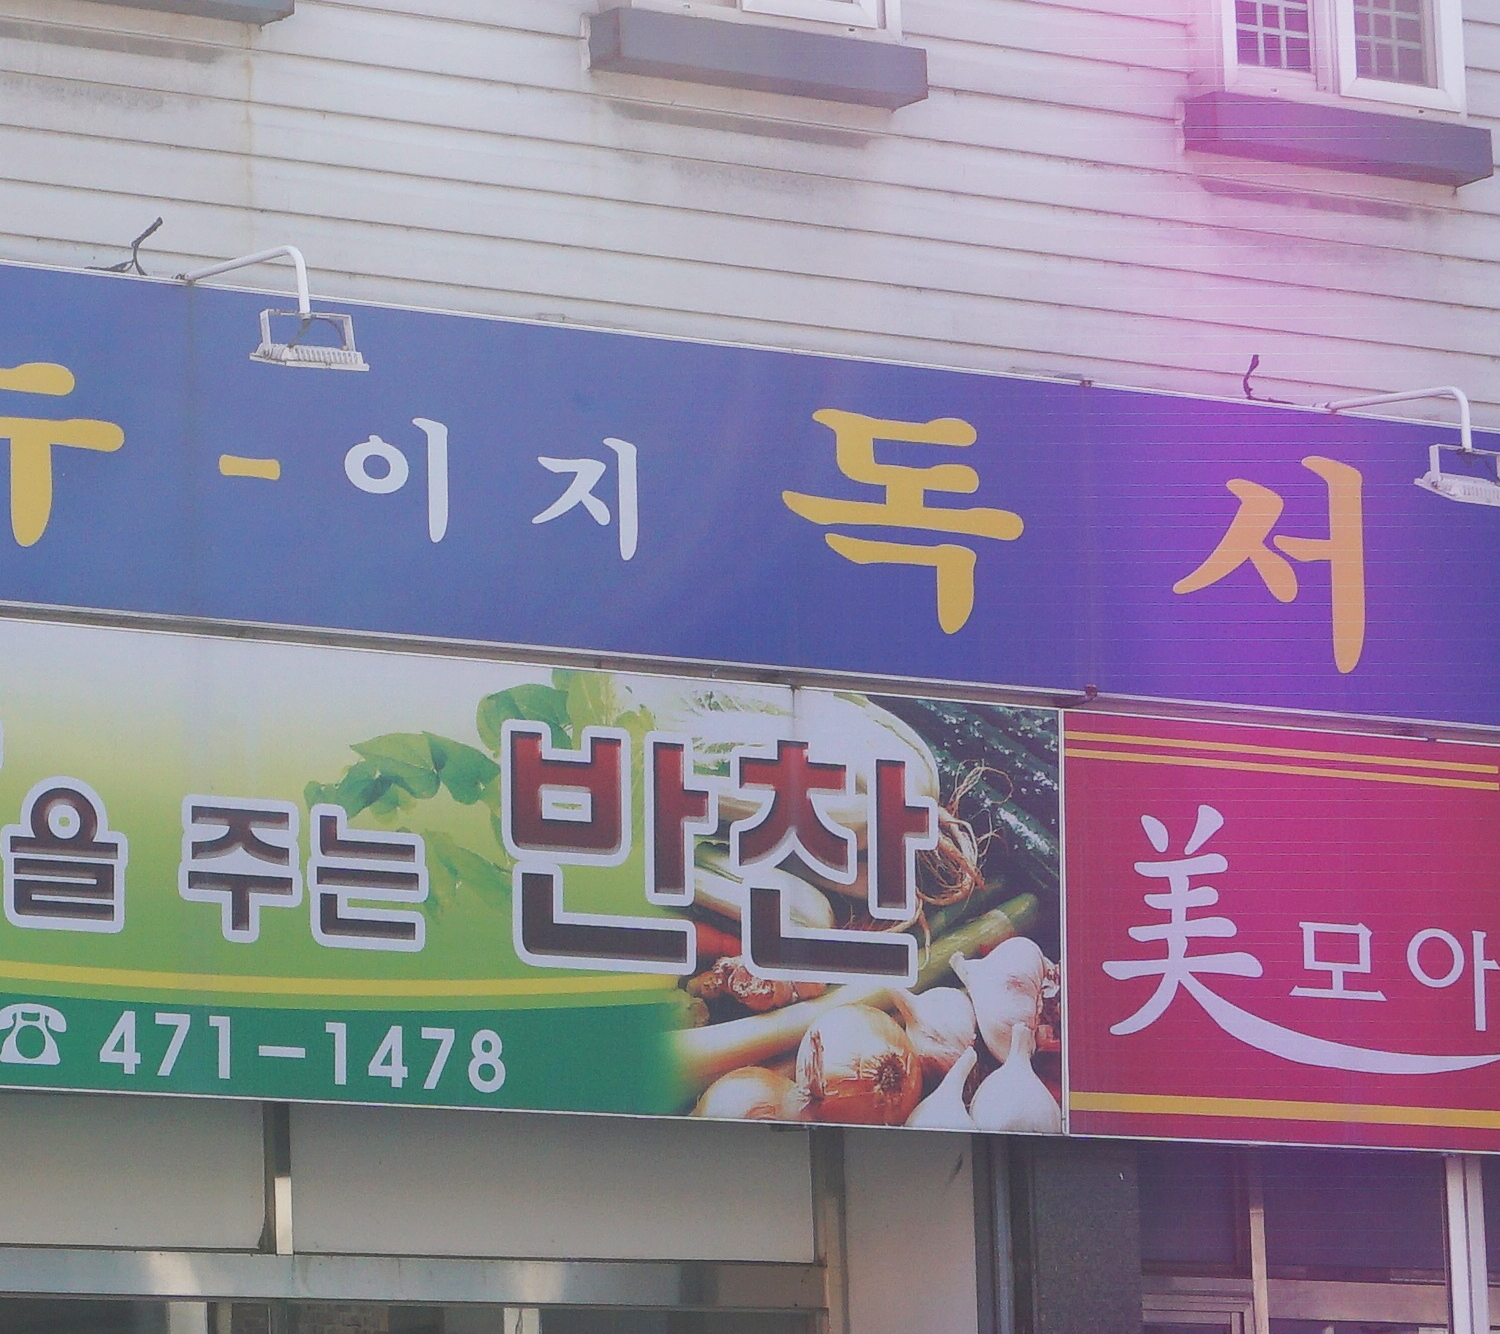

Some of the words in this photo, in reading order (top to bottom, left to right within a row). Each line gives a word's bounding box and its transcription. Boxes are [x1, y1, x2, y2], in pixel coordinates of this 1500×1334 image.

[178, 794, 429, 952] 주는
[502, 719, 944, 989] 반찬
[98, 1008, 506, 1095] 471-1478
